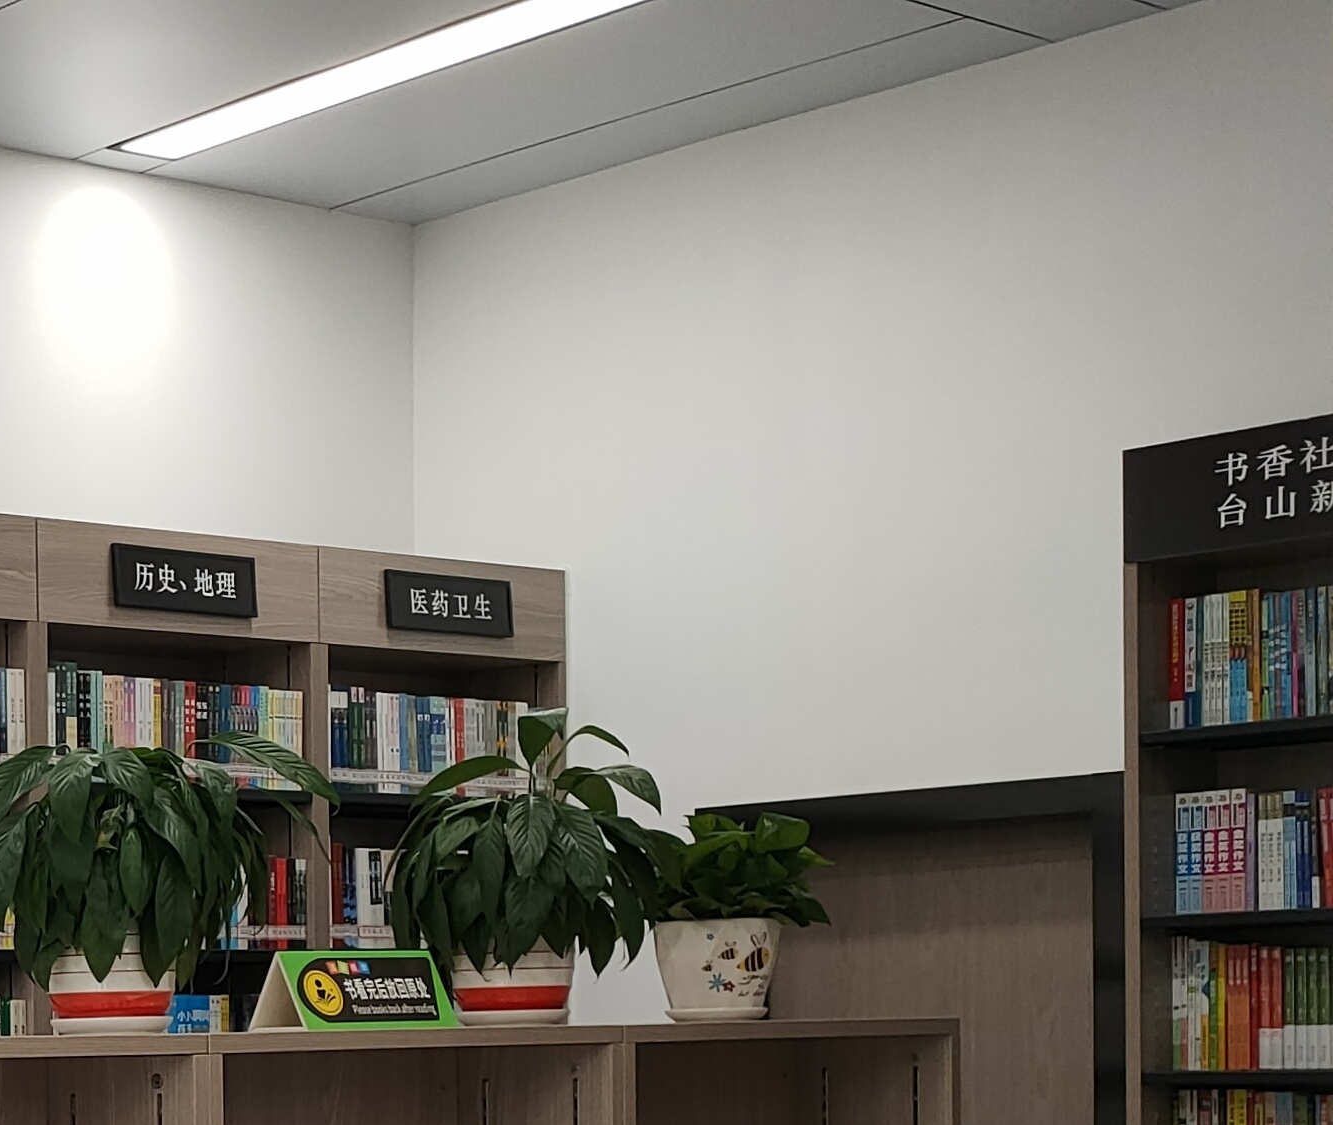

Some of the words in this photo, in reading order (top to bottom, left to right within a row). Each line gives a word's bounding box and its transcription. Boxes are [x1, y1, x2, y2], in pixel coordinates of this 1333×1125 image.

[134, 562, 237, 599] 历史、地理
[409, 587, 493, 621] 医药卫生
[343, 977, 431, 1000] 书看完后放回原处
